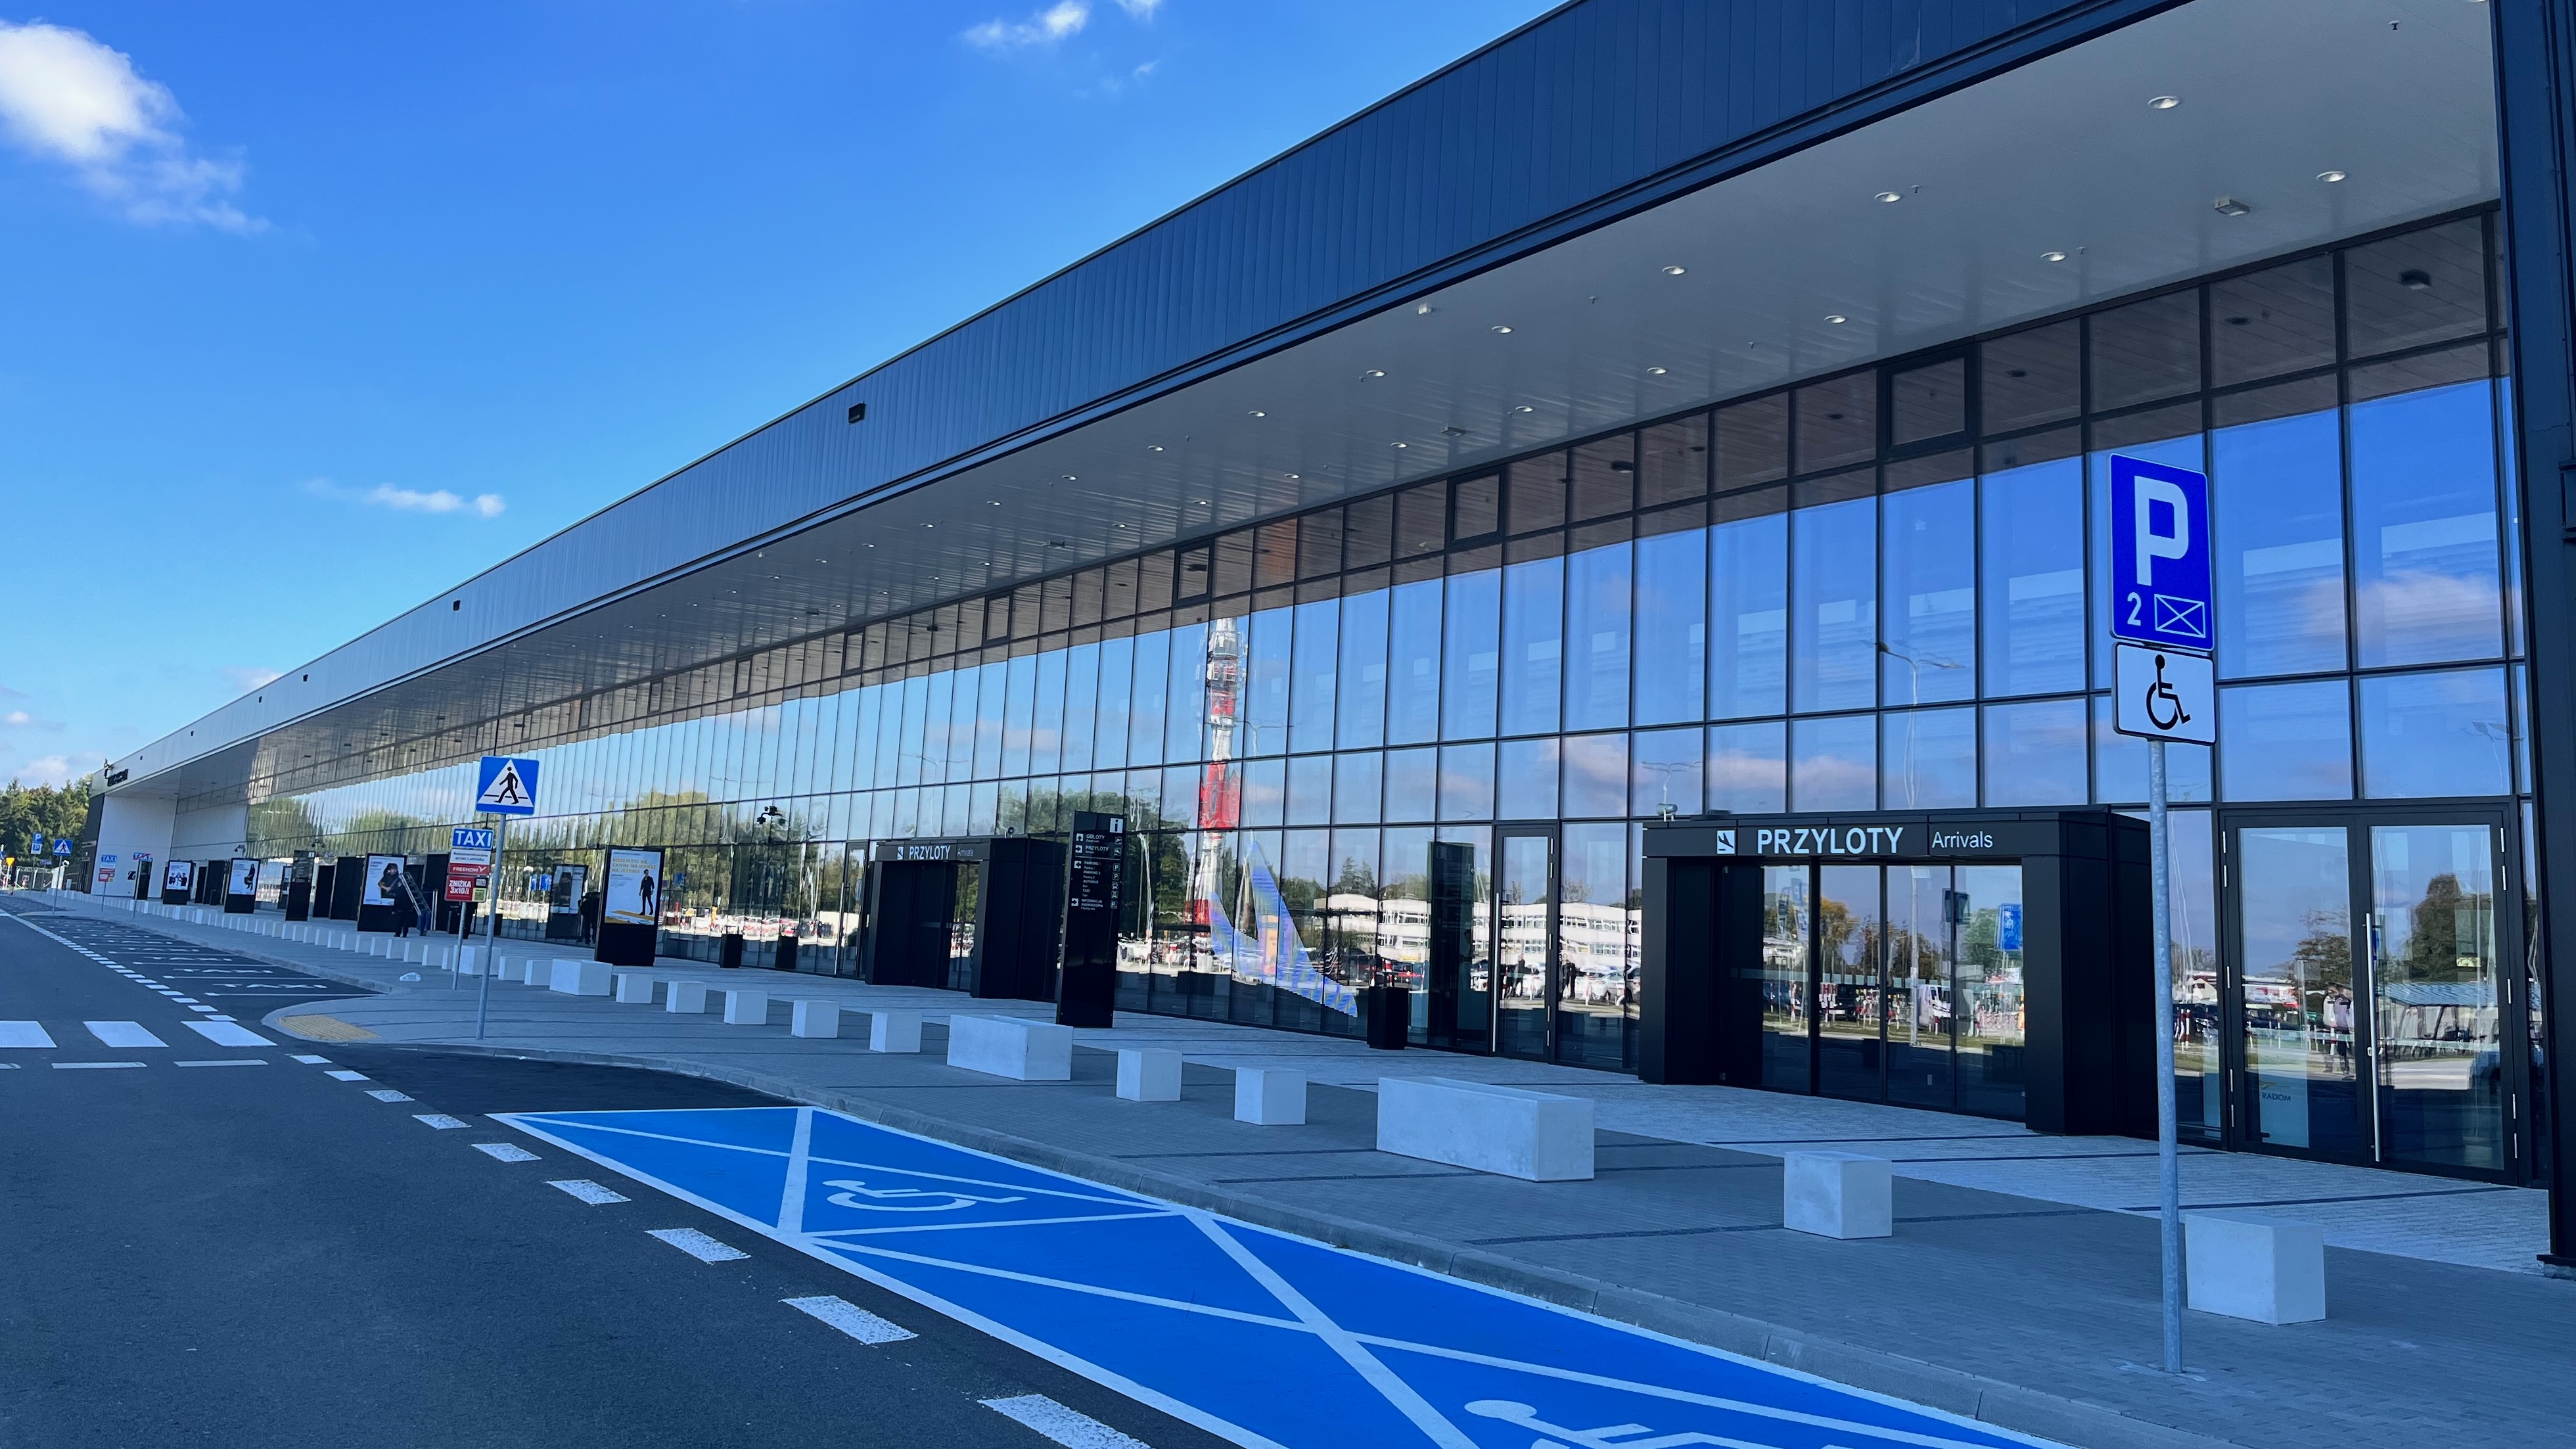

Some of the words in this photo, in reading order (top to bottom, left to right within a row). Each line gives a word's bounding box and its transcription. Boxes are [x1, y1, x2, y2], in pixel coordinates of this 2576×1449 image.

[2134, 475, 2189, 586] P
[2127, 592, 2142, 626] 2
[455, 830, 492, 847] TAXI
[1757, 827, 1904, 854] PRZYLOTY
[1931, 831, 1993, 848] Arrivals
[909, 845, 951, 860] PRZYLOTY
